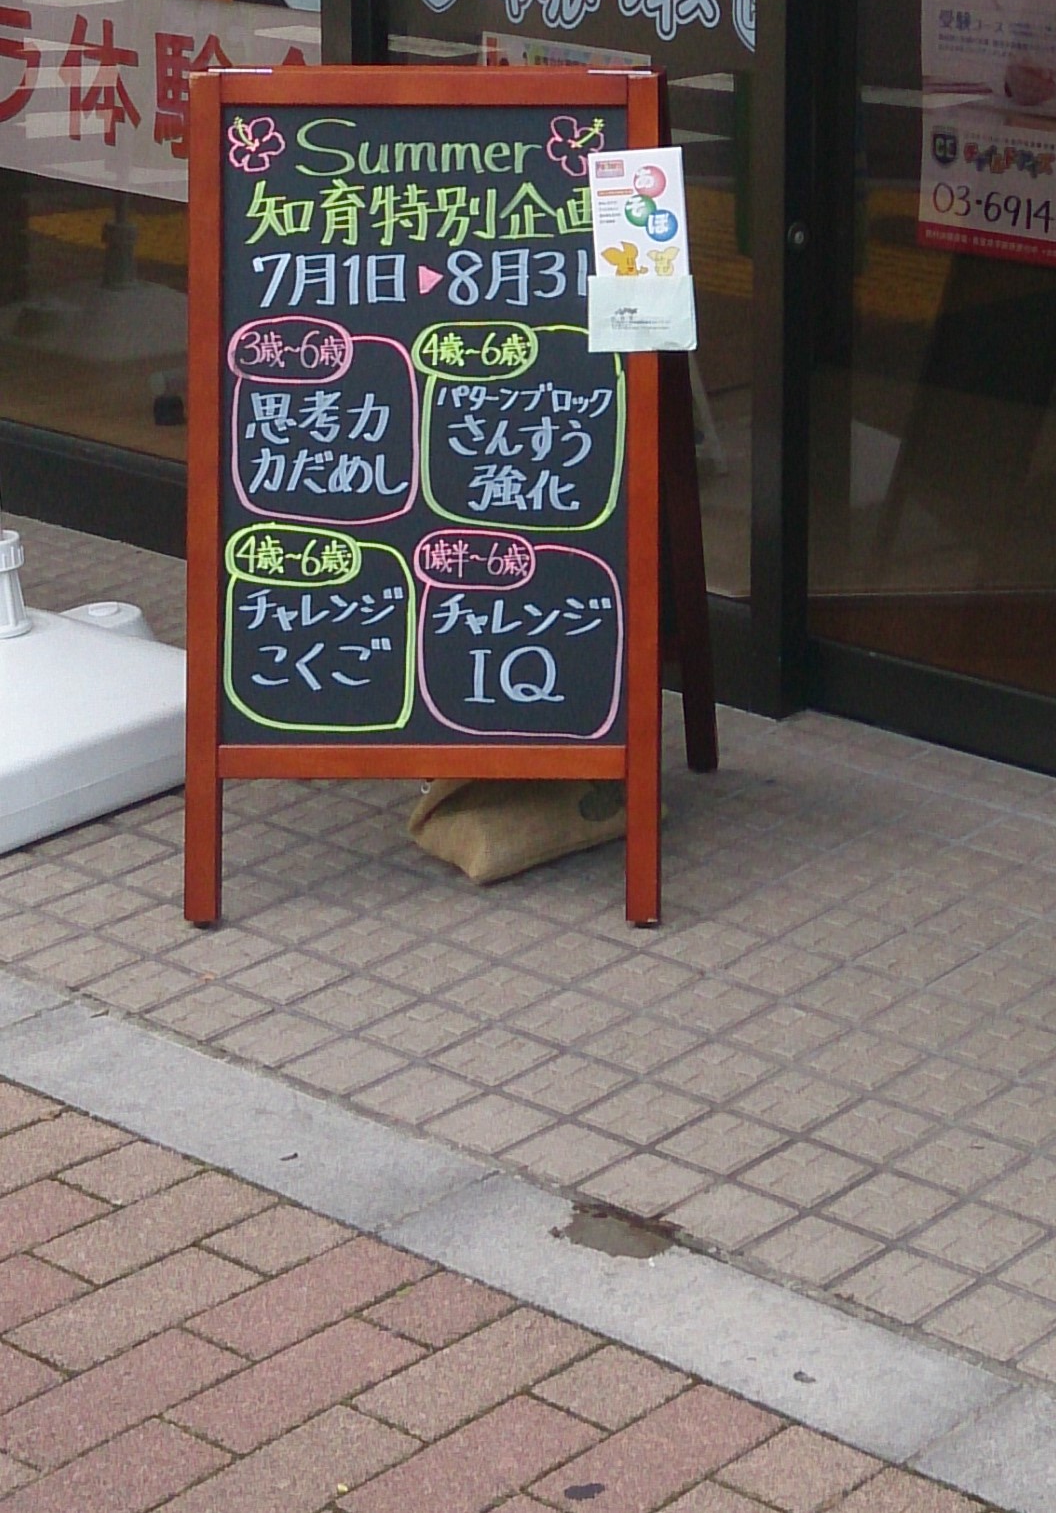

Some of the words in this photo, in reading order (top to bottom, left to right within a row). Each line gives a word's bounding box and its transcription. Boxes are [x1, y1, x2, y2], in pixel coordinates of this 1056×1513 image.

[294, 117, 543, 177] Summer
[244, 178, 596, 247] 知育特別企画
[252, 248, 409, 309] 7月1日
[245, 390, 391, 445] 思考力
[436, 381, 613, 420] パターンブロック
[447, 415, 594, 469] さんすう
[248, 447, 410, 497] 力だめし
[467, 464, 580, 512] 強化
[237, 585, 405, 634] チャレンジ
[431, 592, 614, 637] チャレンジ
[251, 636, 392, 692] こくご
[464, 644, 566, 705] IQ
